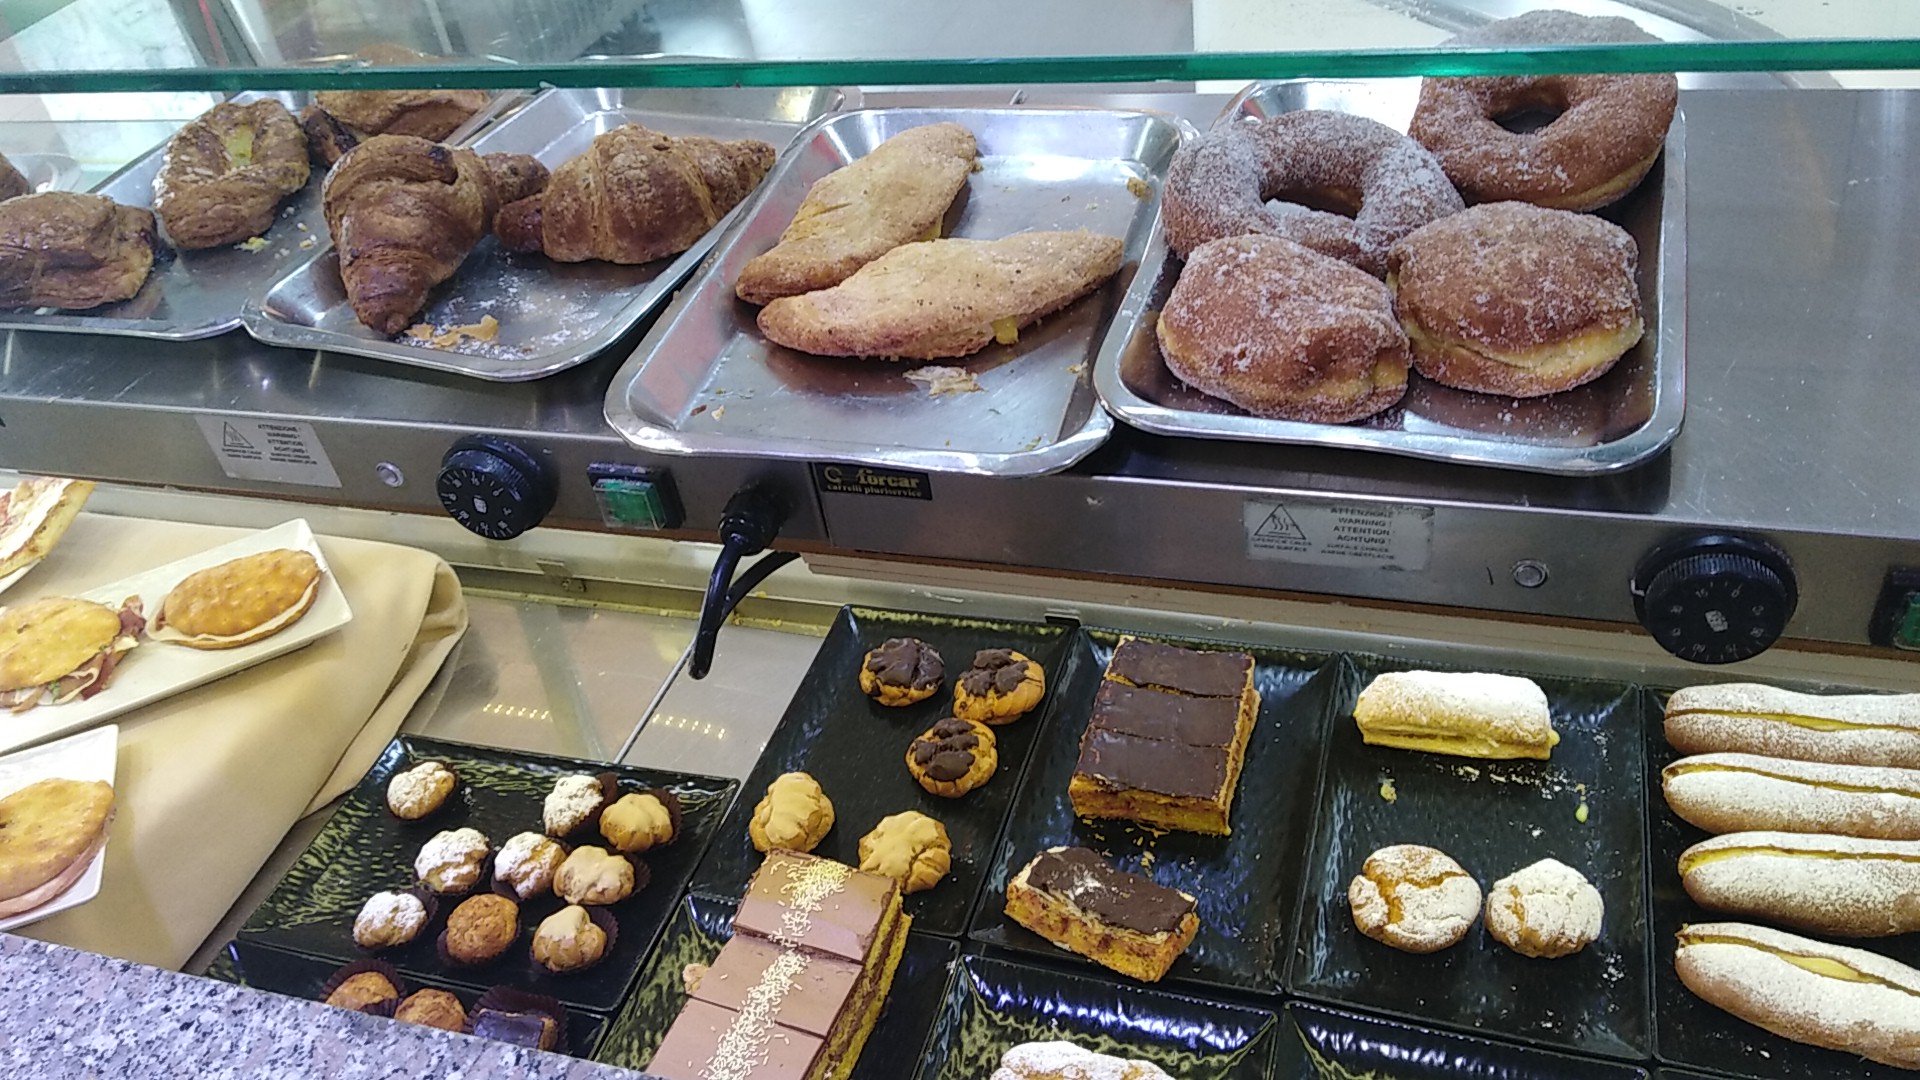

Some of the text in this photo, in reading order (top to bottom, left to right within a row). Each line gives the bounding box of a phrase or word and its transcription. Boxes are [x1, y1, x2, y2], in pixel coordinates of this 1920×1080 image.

[856, 468, 920, 488] forcar
[827, 484, 862, 493] carrelli
[864, 486, 922, 497] pluriservice
[1333, 525, 1390, 536] ATTENTION
[1337, 534, 1386, 544] ACHTUNG
